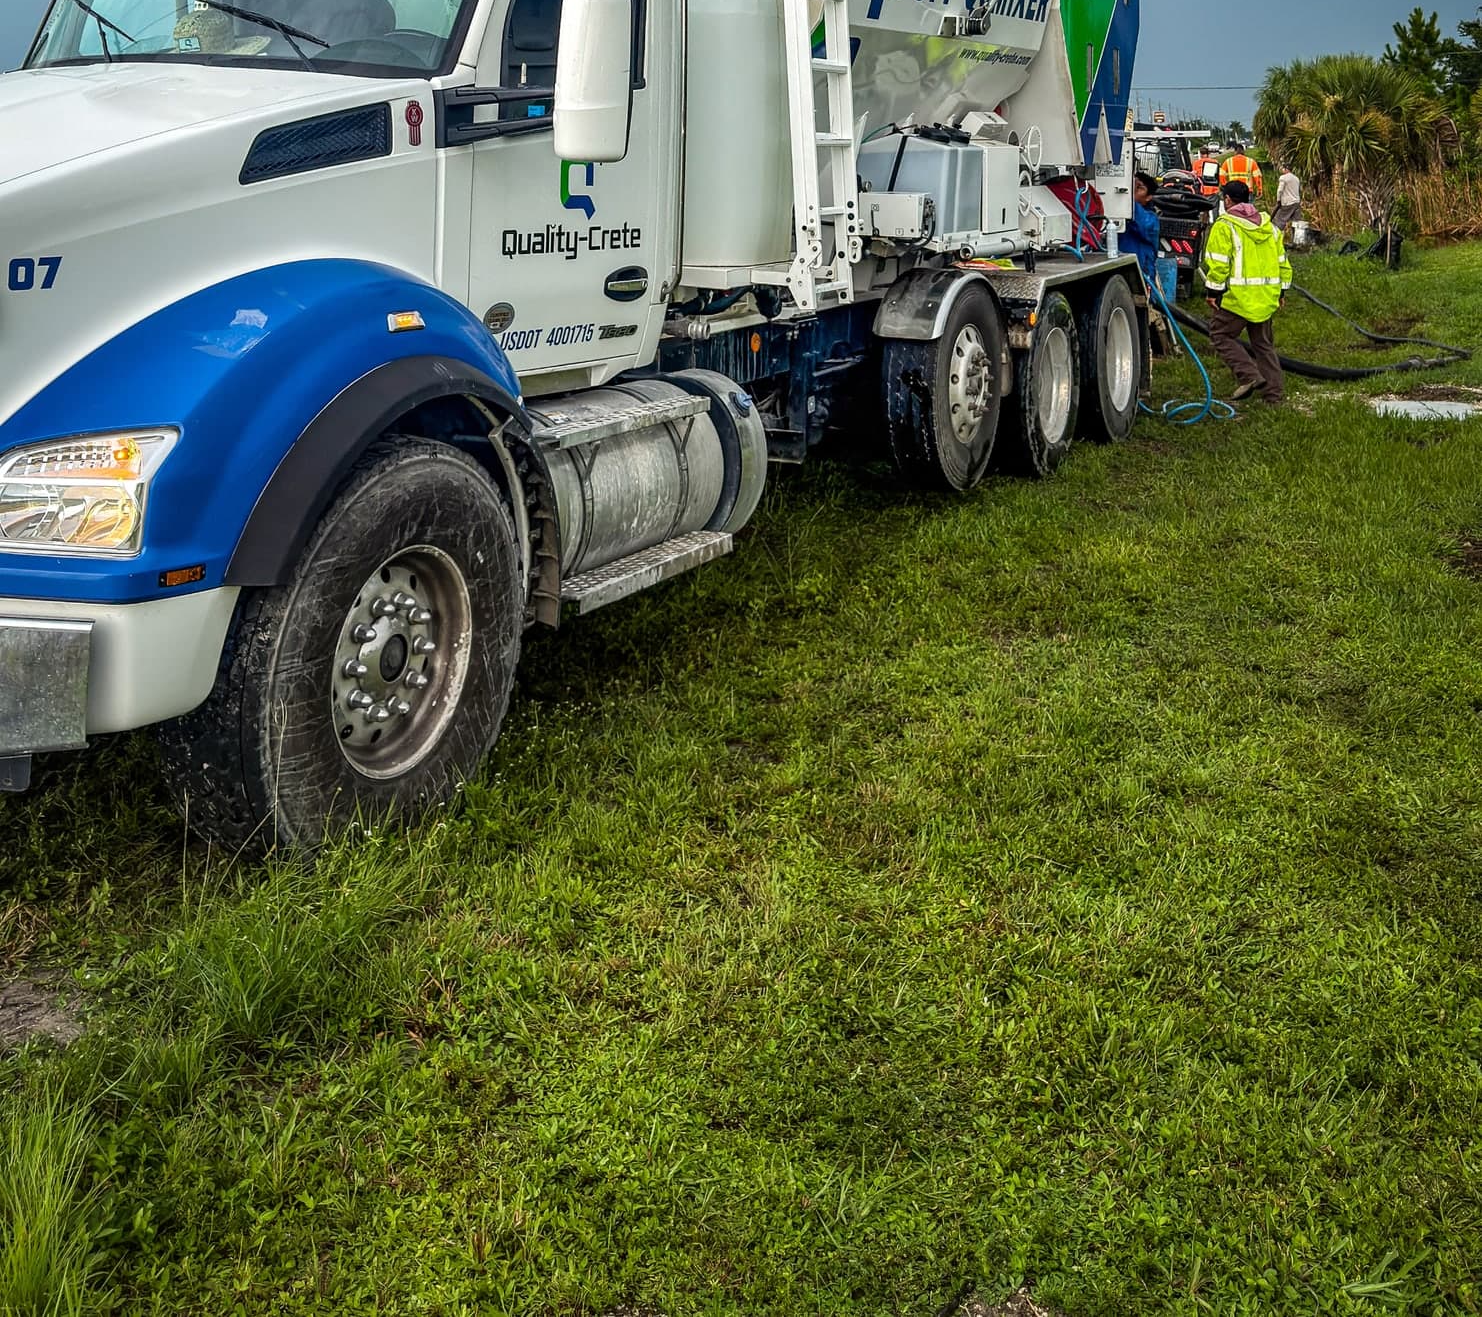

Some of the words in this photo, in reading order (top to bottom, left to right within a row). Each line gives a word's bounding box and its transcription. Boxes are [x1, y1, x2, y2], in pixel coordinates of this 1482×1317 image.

[502, 222, 641, 260] Quality-Crete
[8, 257, 62, 290] 07
[500, 329, 542, 351] USDOT
[546, 324, 594, 346] 4001715
